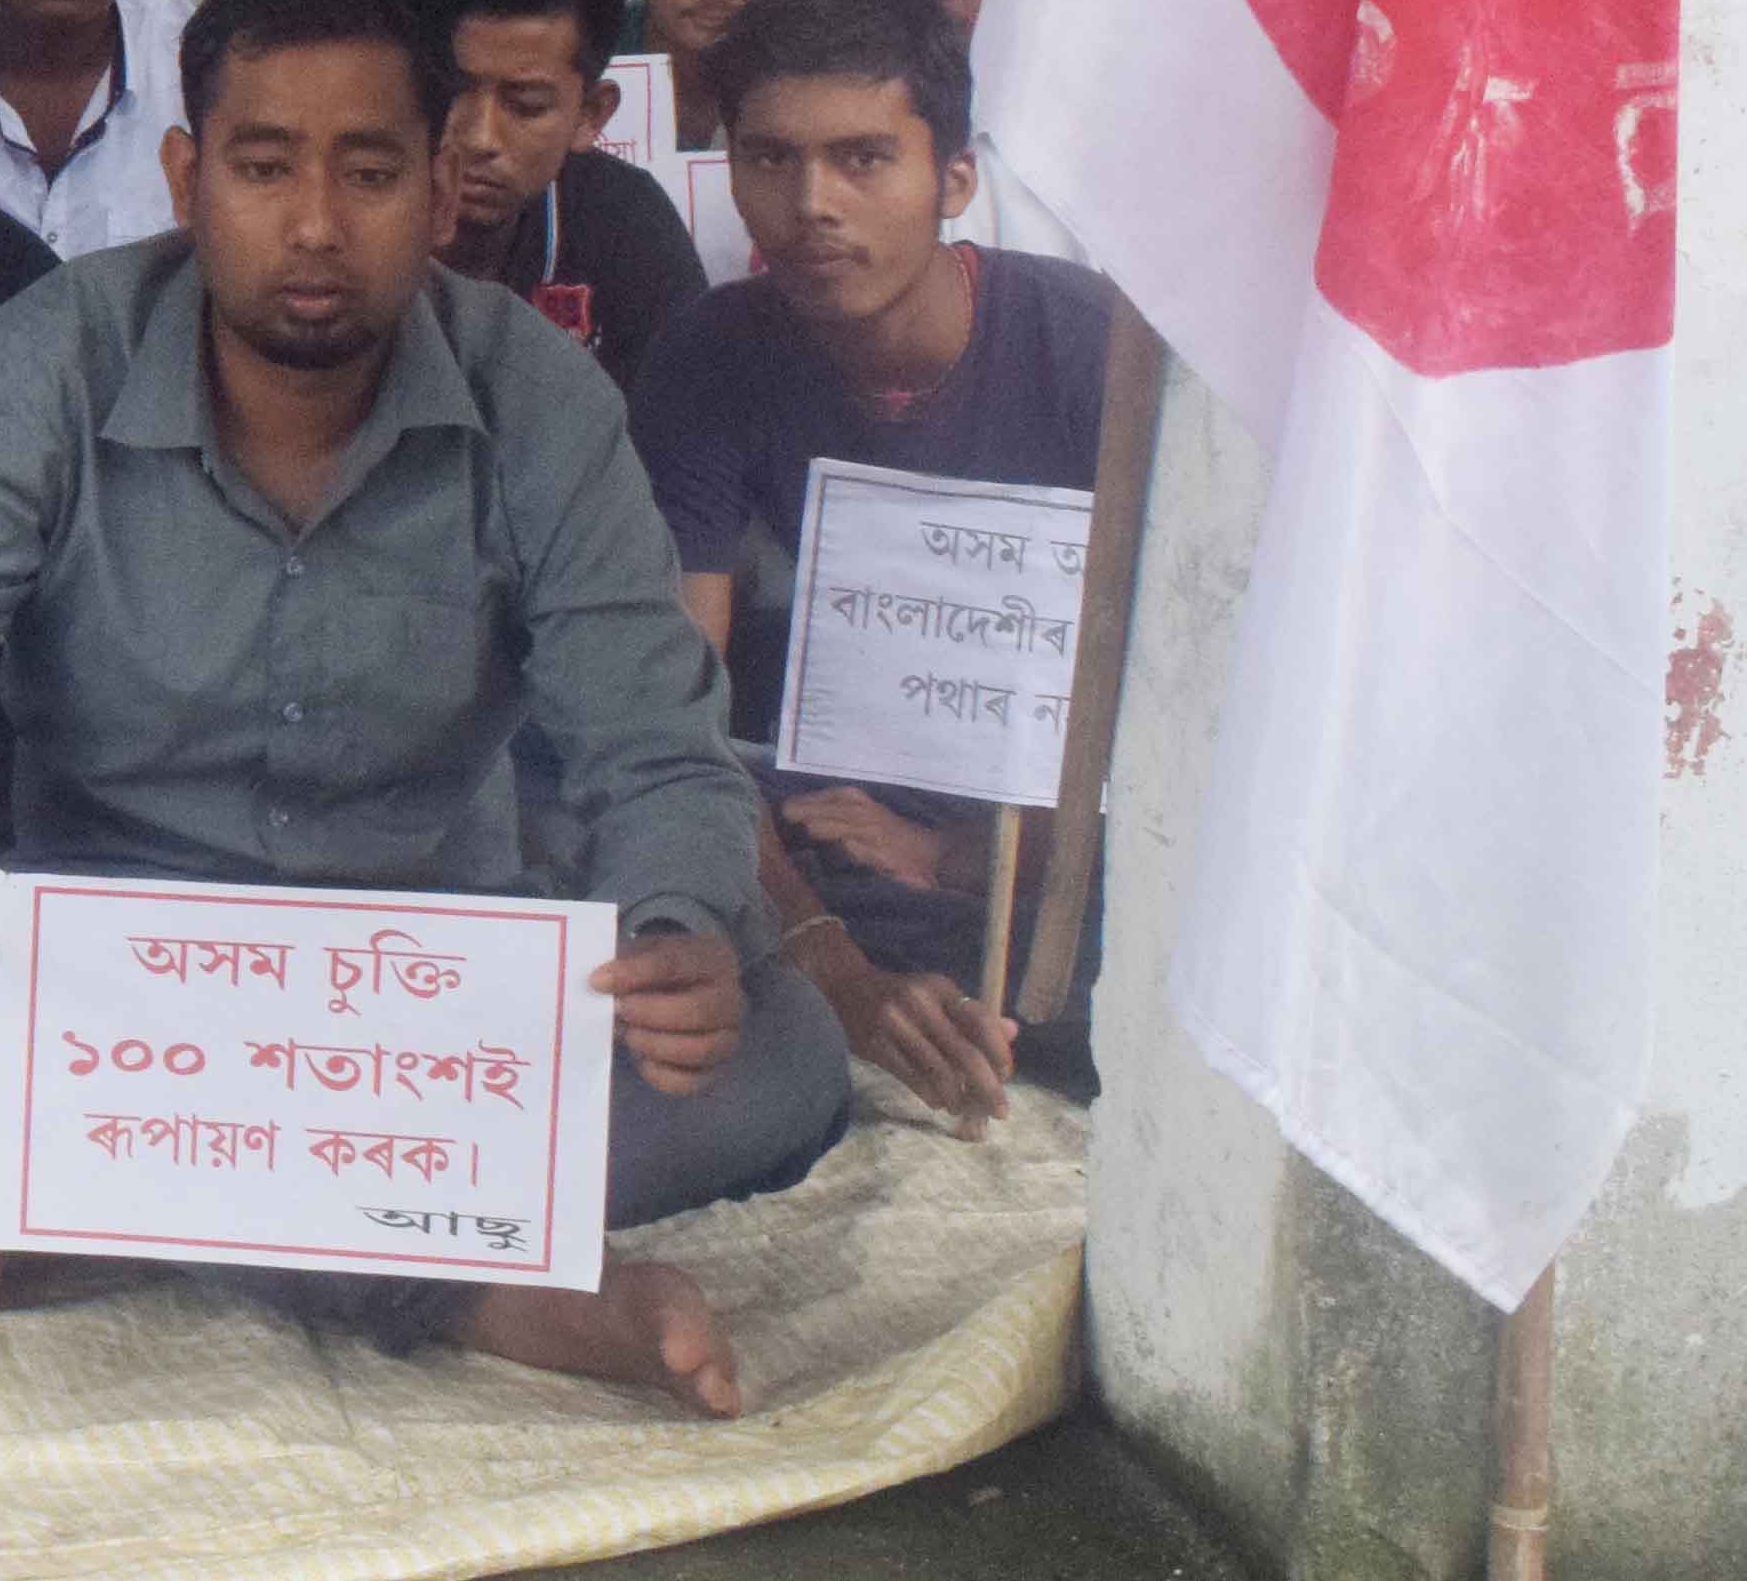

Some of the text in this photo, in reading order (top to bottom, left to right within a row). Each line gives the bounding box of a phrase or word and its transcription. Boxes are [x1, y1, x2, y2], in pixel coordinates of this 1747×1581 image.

[920, 520, 1031, 573] অসম
[900, 671, 1016, 727] পথাৰ
[126, 928, 468, 1017] অসম চুক্তি
[61, 1030, 532, 1111] ১০০ শতাংশই
